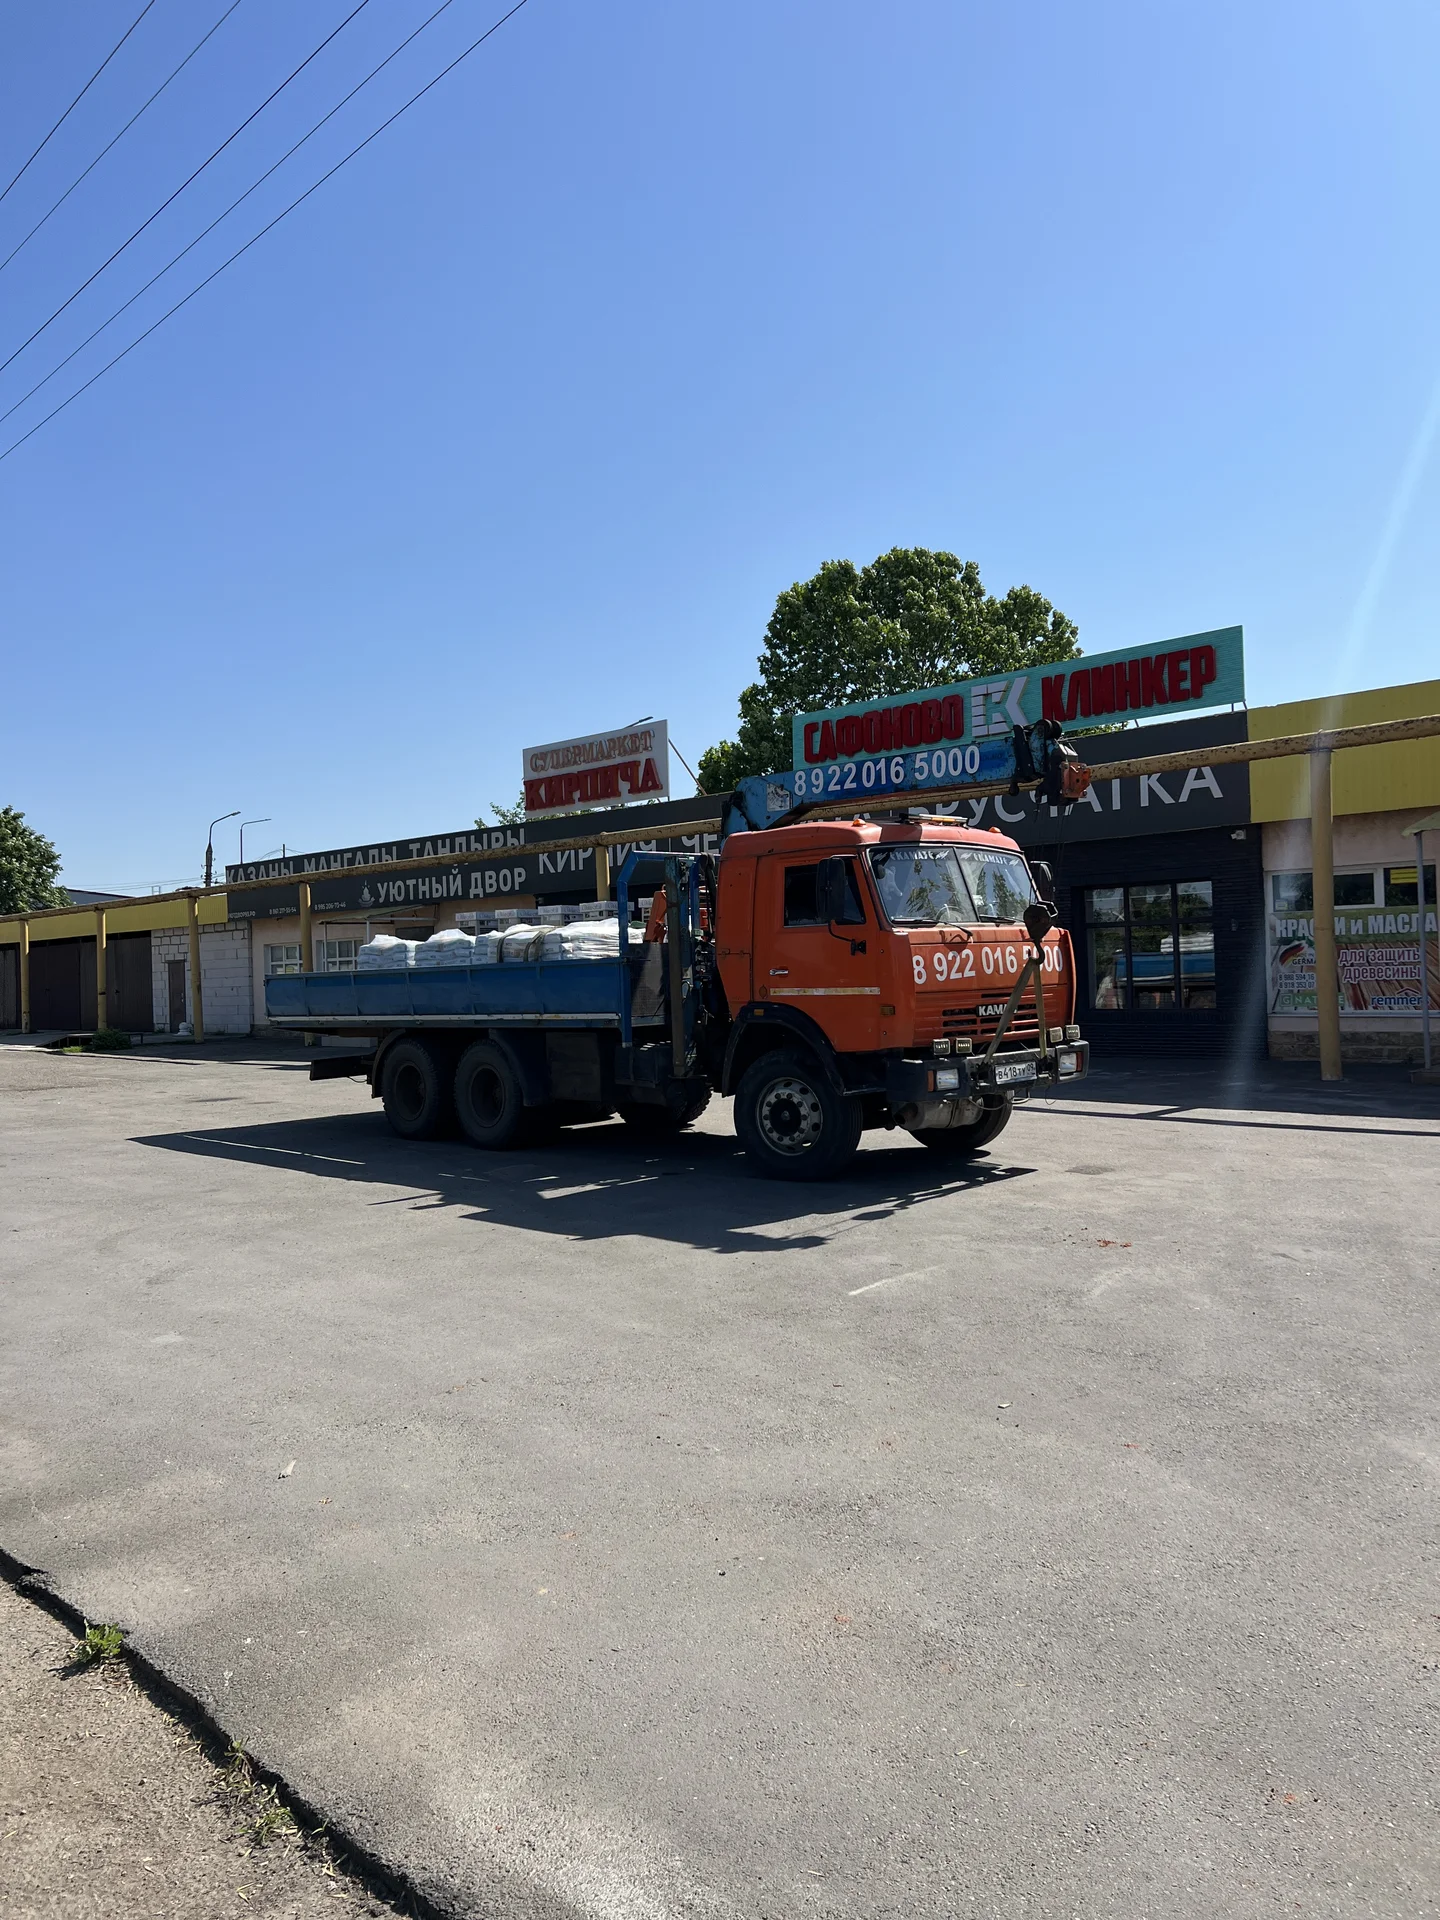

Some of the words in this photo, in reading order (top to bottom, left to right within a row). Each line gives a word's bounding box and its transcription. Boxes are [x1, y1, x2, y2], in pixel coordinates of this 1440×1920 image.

[804, 694, 964, 763] САФОНОВО
[1041, 645, 1216, 721] КЛИНКЕР
[530, 729, 655, 772] СУПЕРМАРКЕТ
[914, 745, 980, 781] 5000
[524, 758, 663, 811] КИРПИЧА
[227, 861, 293, 884] КАЗАНЫ
[377, 868, 462, 903] УЮТНЫЙ
[470, 867, 526, 898] ДВОР
[912, 955, 927, 984] 8
[933, 948, 976, 982] 922
[981, 946, 1018, 975] 016
[1340, 950, 1367, 966] для
[1344, 966, 1421, 982] древесины
[1371, 995, 1429, 1006] remmer
